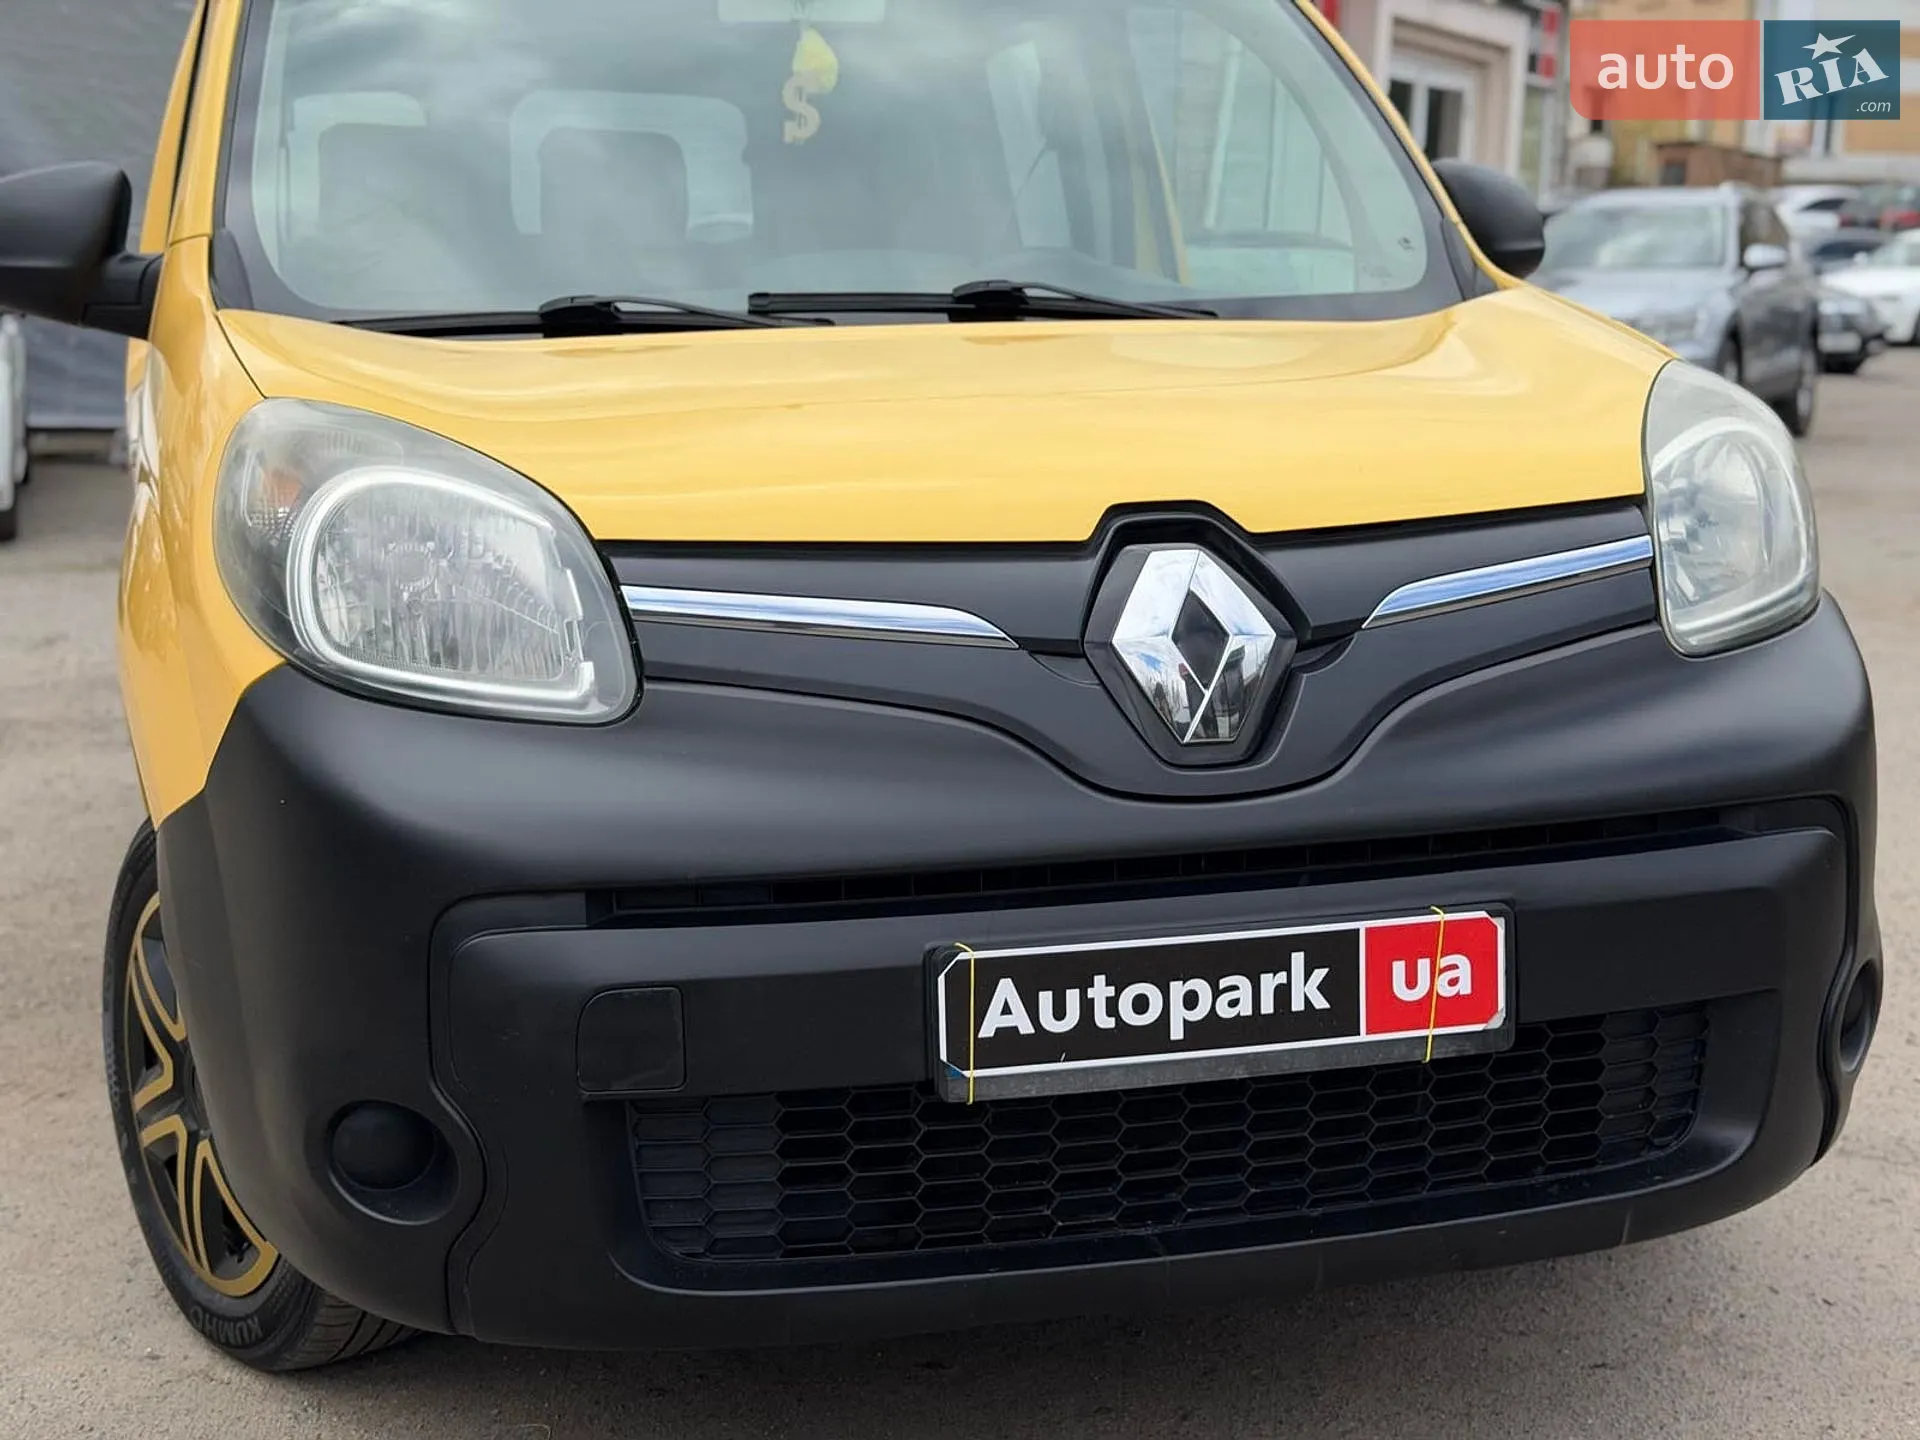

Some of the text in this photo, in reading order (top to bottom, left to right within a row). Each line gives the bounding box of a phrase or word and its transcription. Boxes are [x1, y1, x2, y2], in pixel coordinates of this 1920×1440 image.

[977, 951, 1472, 1041] Autopark ua
[190, 1304, 264, 1347] KUMHO
